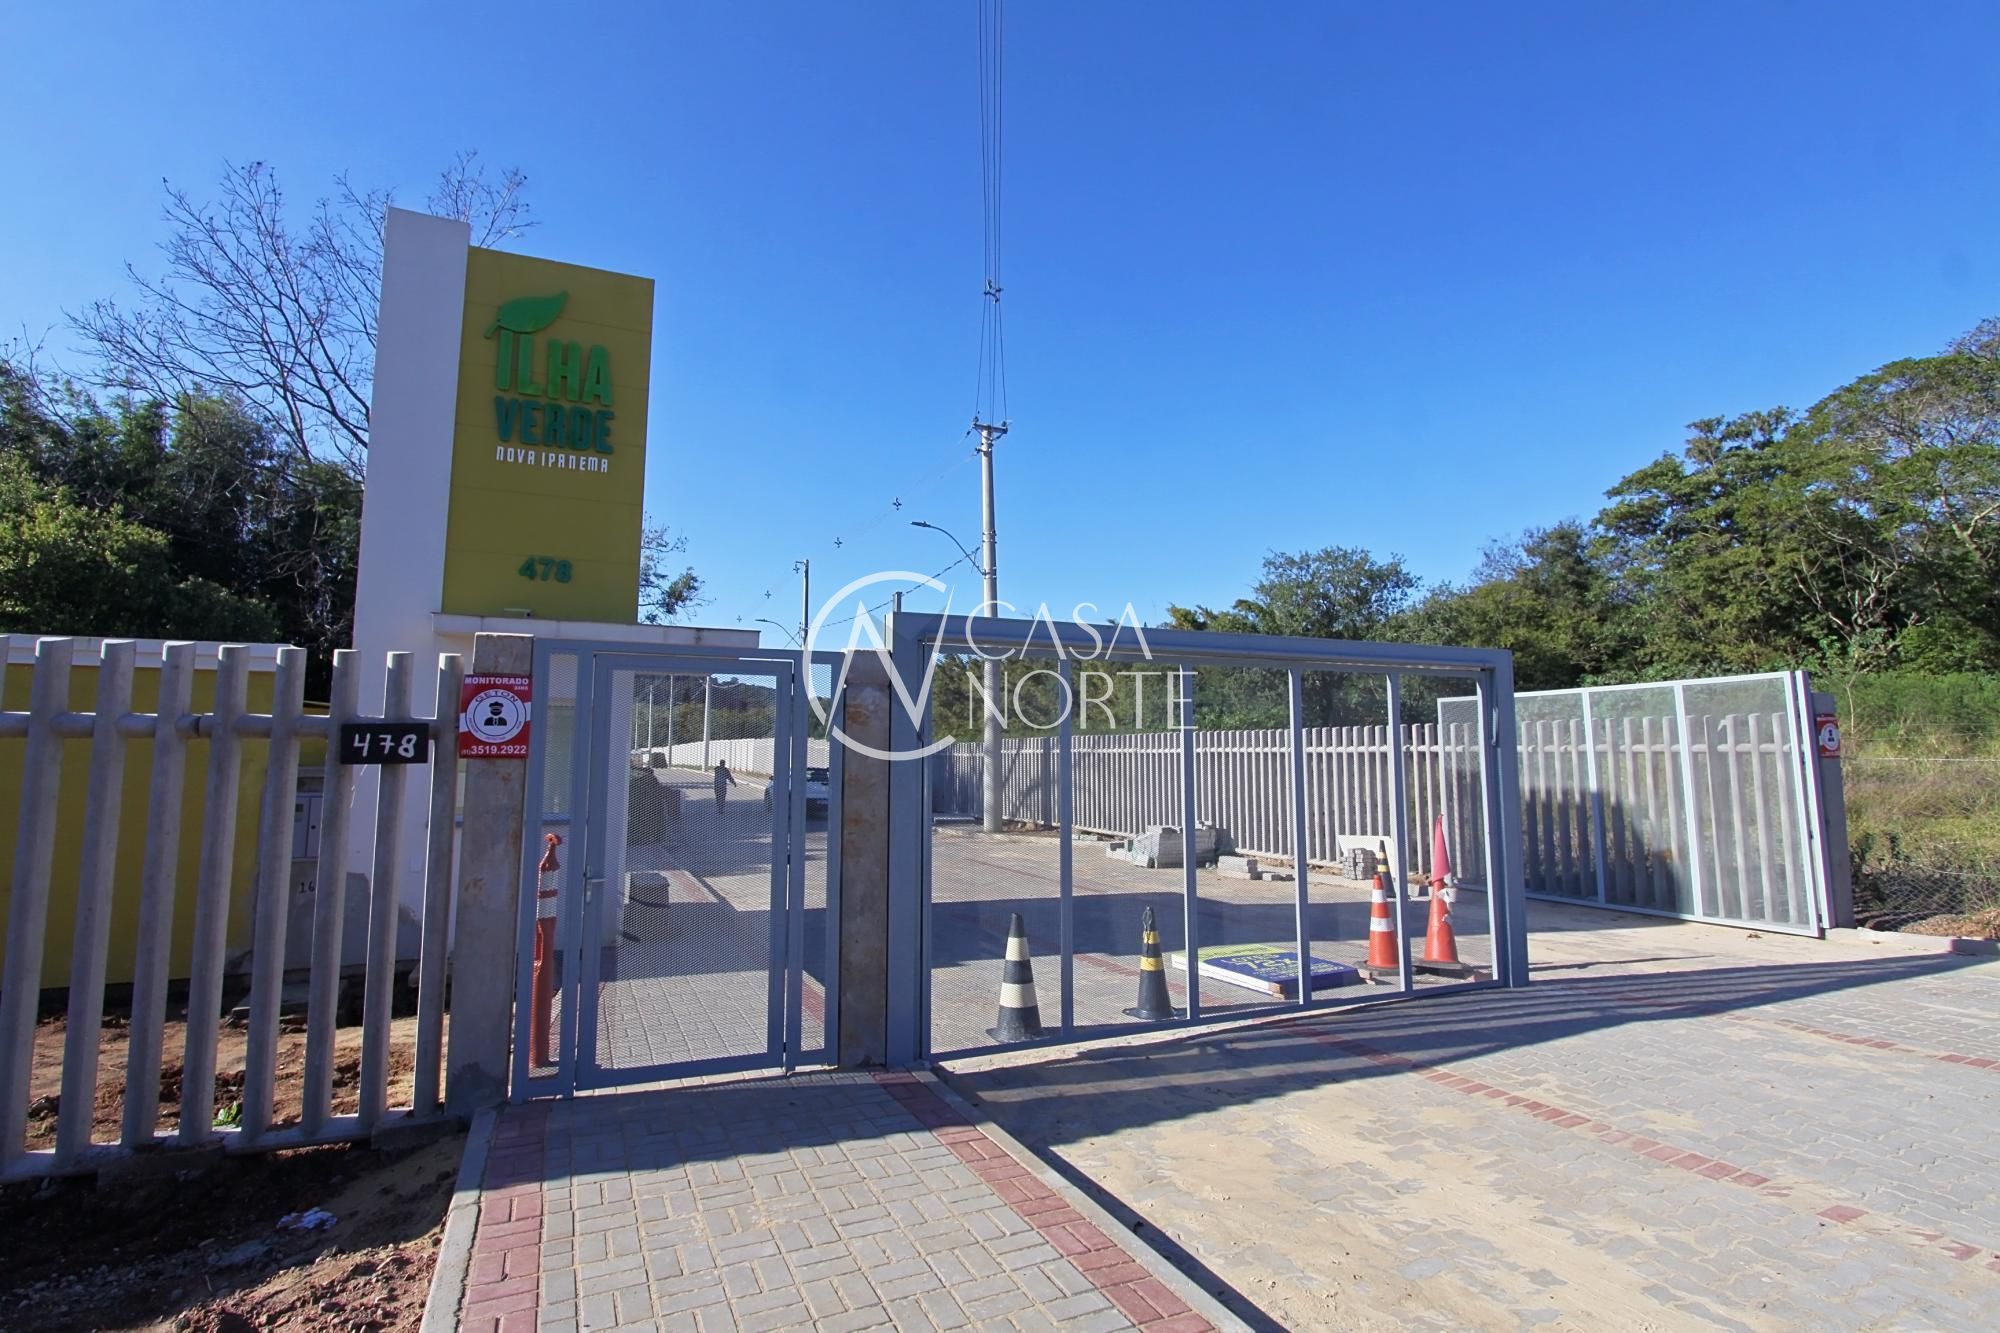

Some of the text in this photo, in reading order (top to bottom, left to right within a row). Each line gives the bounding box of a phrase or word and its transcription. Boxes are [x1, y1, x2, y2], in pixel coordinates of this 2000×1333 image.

[496, 330, 614, 406] ILHA
[494, 396, 615, 453] VERDE
[496, 446, 608, 473] NOVA IPANEMA
[518, 555, 573, 584] 478
[464, 677, 529, 685] MONITORADO
[354, 732, 417, 759] 478
[471, 745, 527, 755] 3519.2922
